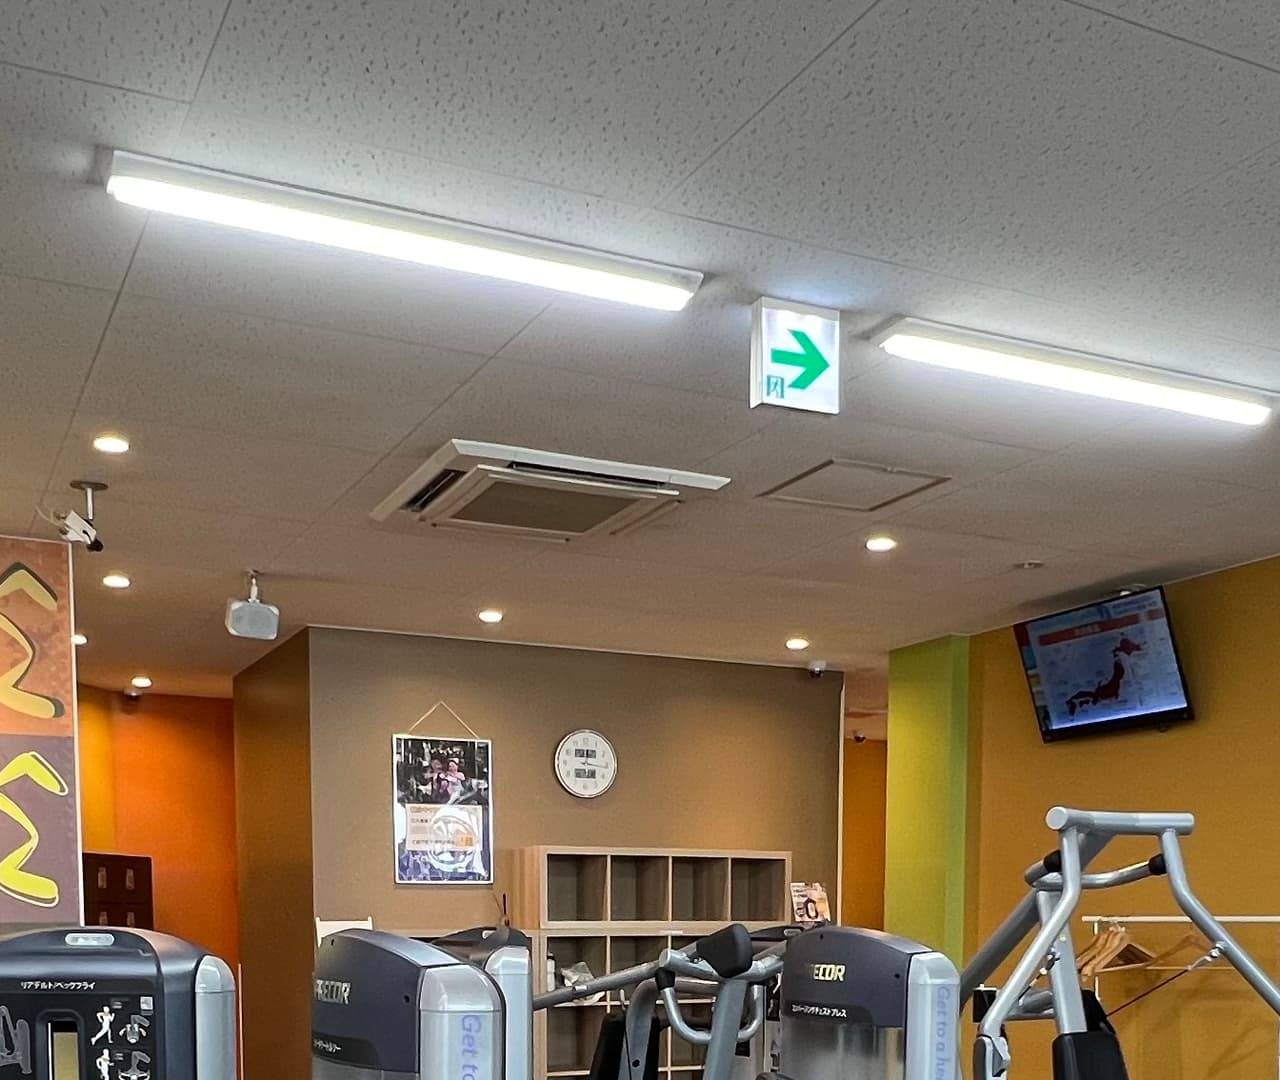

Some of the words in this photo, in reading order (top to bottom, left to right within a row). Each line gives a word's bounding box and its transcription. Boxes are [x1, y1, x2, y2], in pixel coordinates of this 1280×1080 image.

[812, 964, 846, 981] ECOR
[461, 1013, 482, 1058] Get
[936, 1021, 948, 1038] to
[935, 1042, 946, 1052] a
